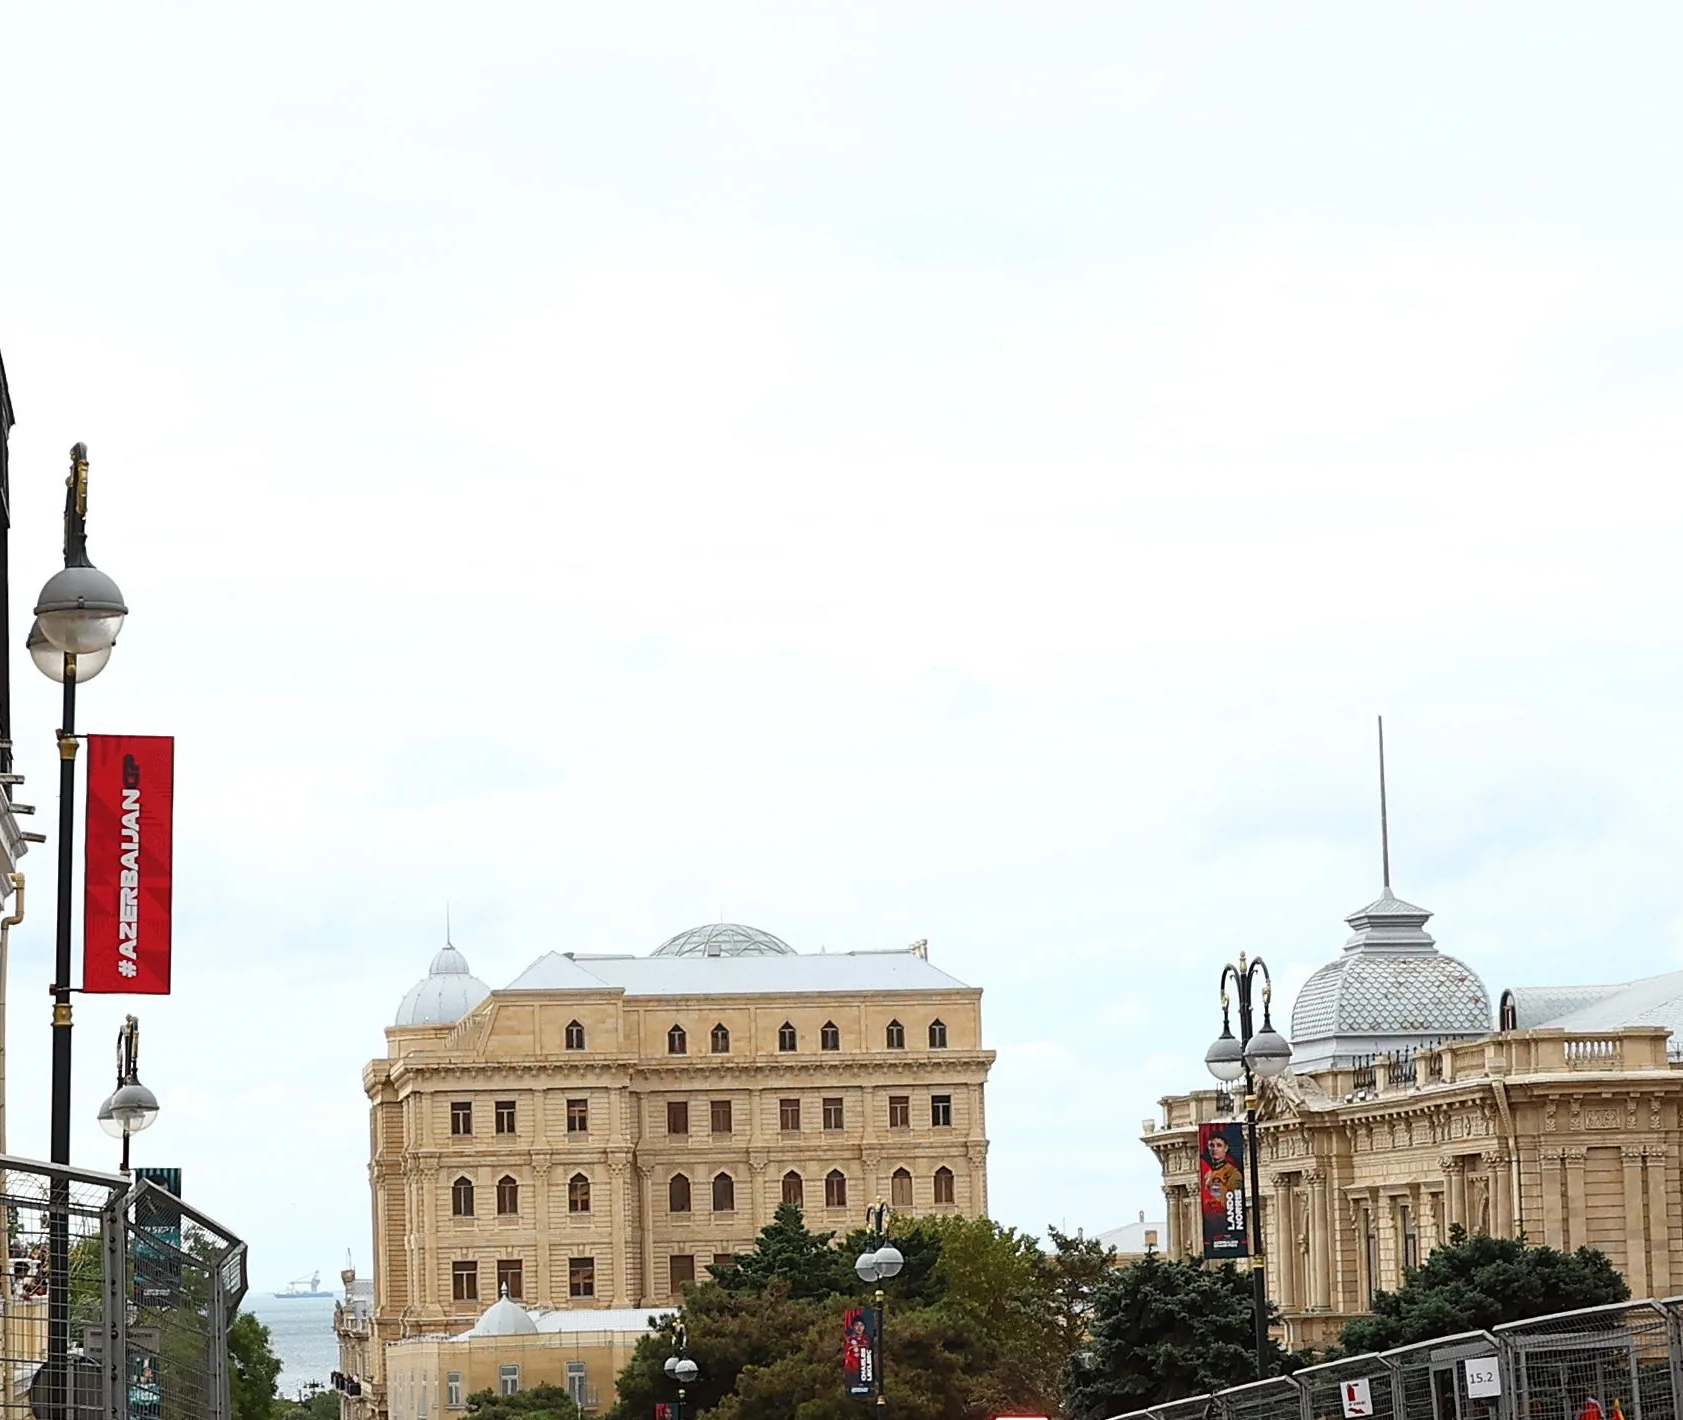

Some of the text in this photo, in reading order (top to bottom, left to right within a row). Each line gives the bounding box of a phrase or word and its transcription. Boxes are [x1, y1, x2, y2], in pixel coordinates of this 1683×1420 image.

[1226, 1191, 1235, 1230] LANDO
[1234, 1189, 1244, 1230] NORRIS
[1470, 1372, 1493, 1385] 15.2
